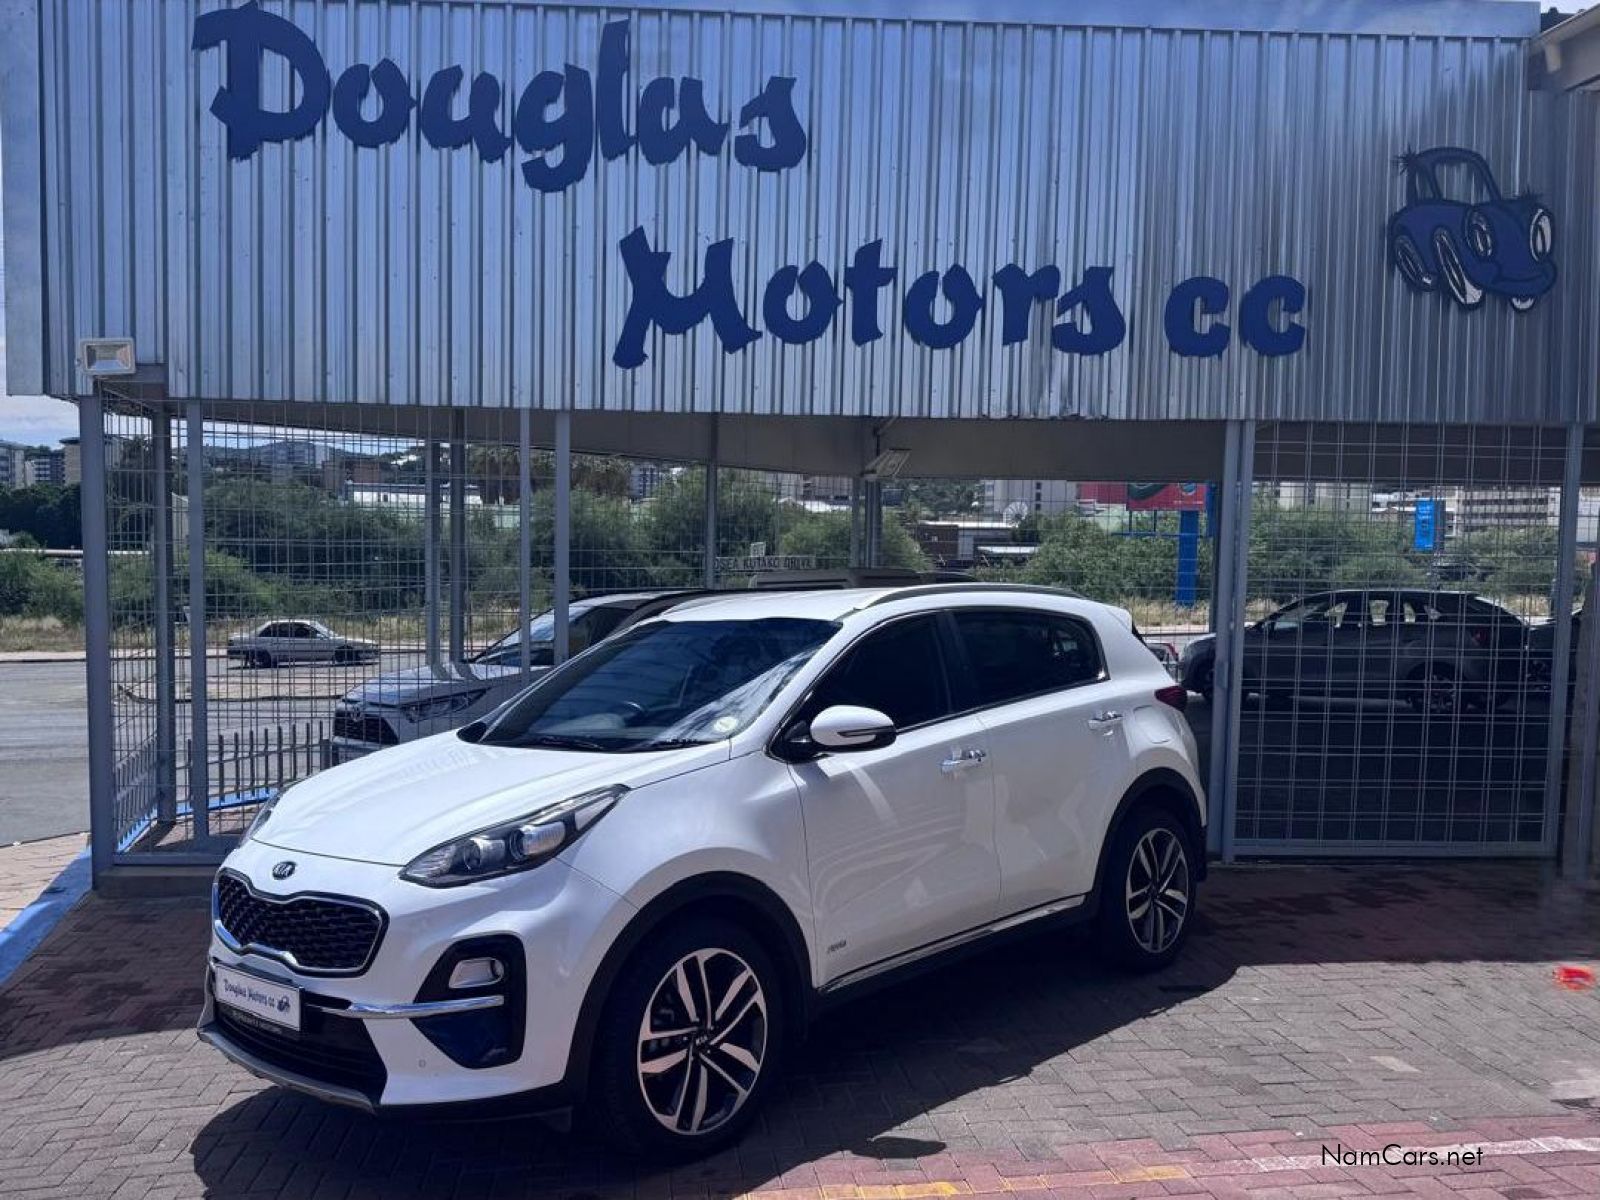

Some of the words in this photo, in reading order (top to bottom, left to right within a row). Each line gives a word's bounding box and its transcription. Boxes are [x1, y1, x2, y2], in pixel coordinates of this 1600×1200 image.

[192, 0, 806, 193] Douglas
[612, 225, 1126, 370] Motors
[1165, 274, 1307, 357] cc
[223, 978, 247, 998] Douglas
[248, 986, 267, 1006] Motors
